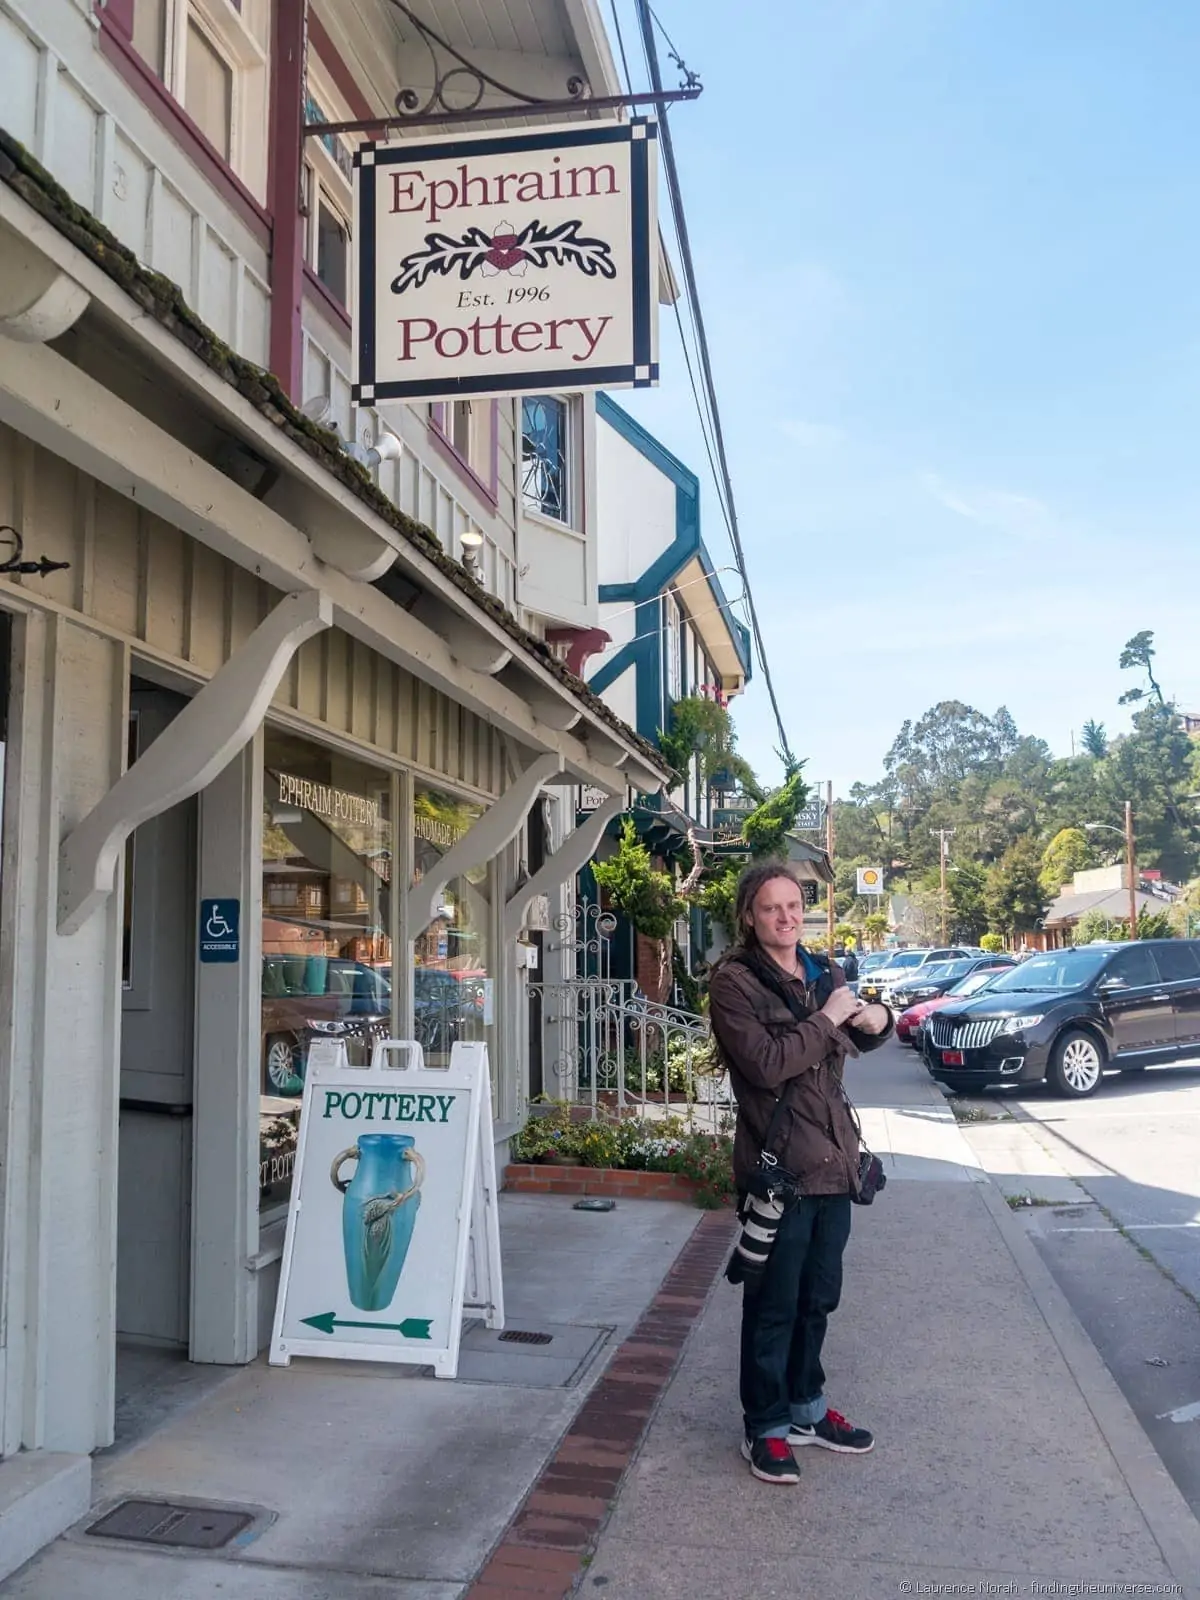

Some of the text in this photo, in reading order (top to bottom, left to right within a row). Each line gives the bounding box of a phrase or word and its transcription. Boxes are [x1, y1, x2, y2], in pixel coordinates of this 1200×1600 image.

[388, 156, 620, 223] Ephraim
[456, 285, 551, 308] Est. 1996
[396, 313, 613, 361] Pottery
[279, 773, 378, 827] EPHRAIM POTTERY
[586, 796, 608, 805] Pot
[414, 815, 452, 846] ANDMADE
[323, 1091, 456, 1123] POTTERY
[271, 1150, 297, 1183] POTT
